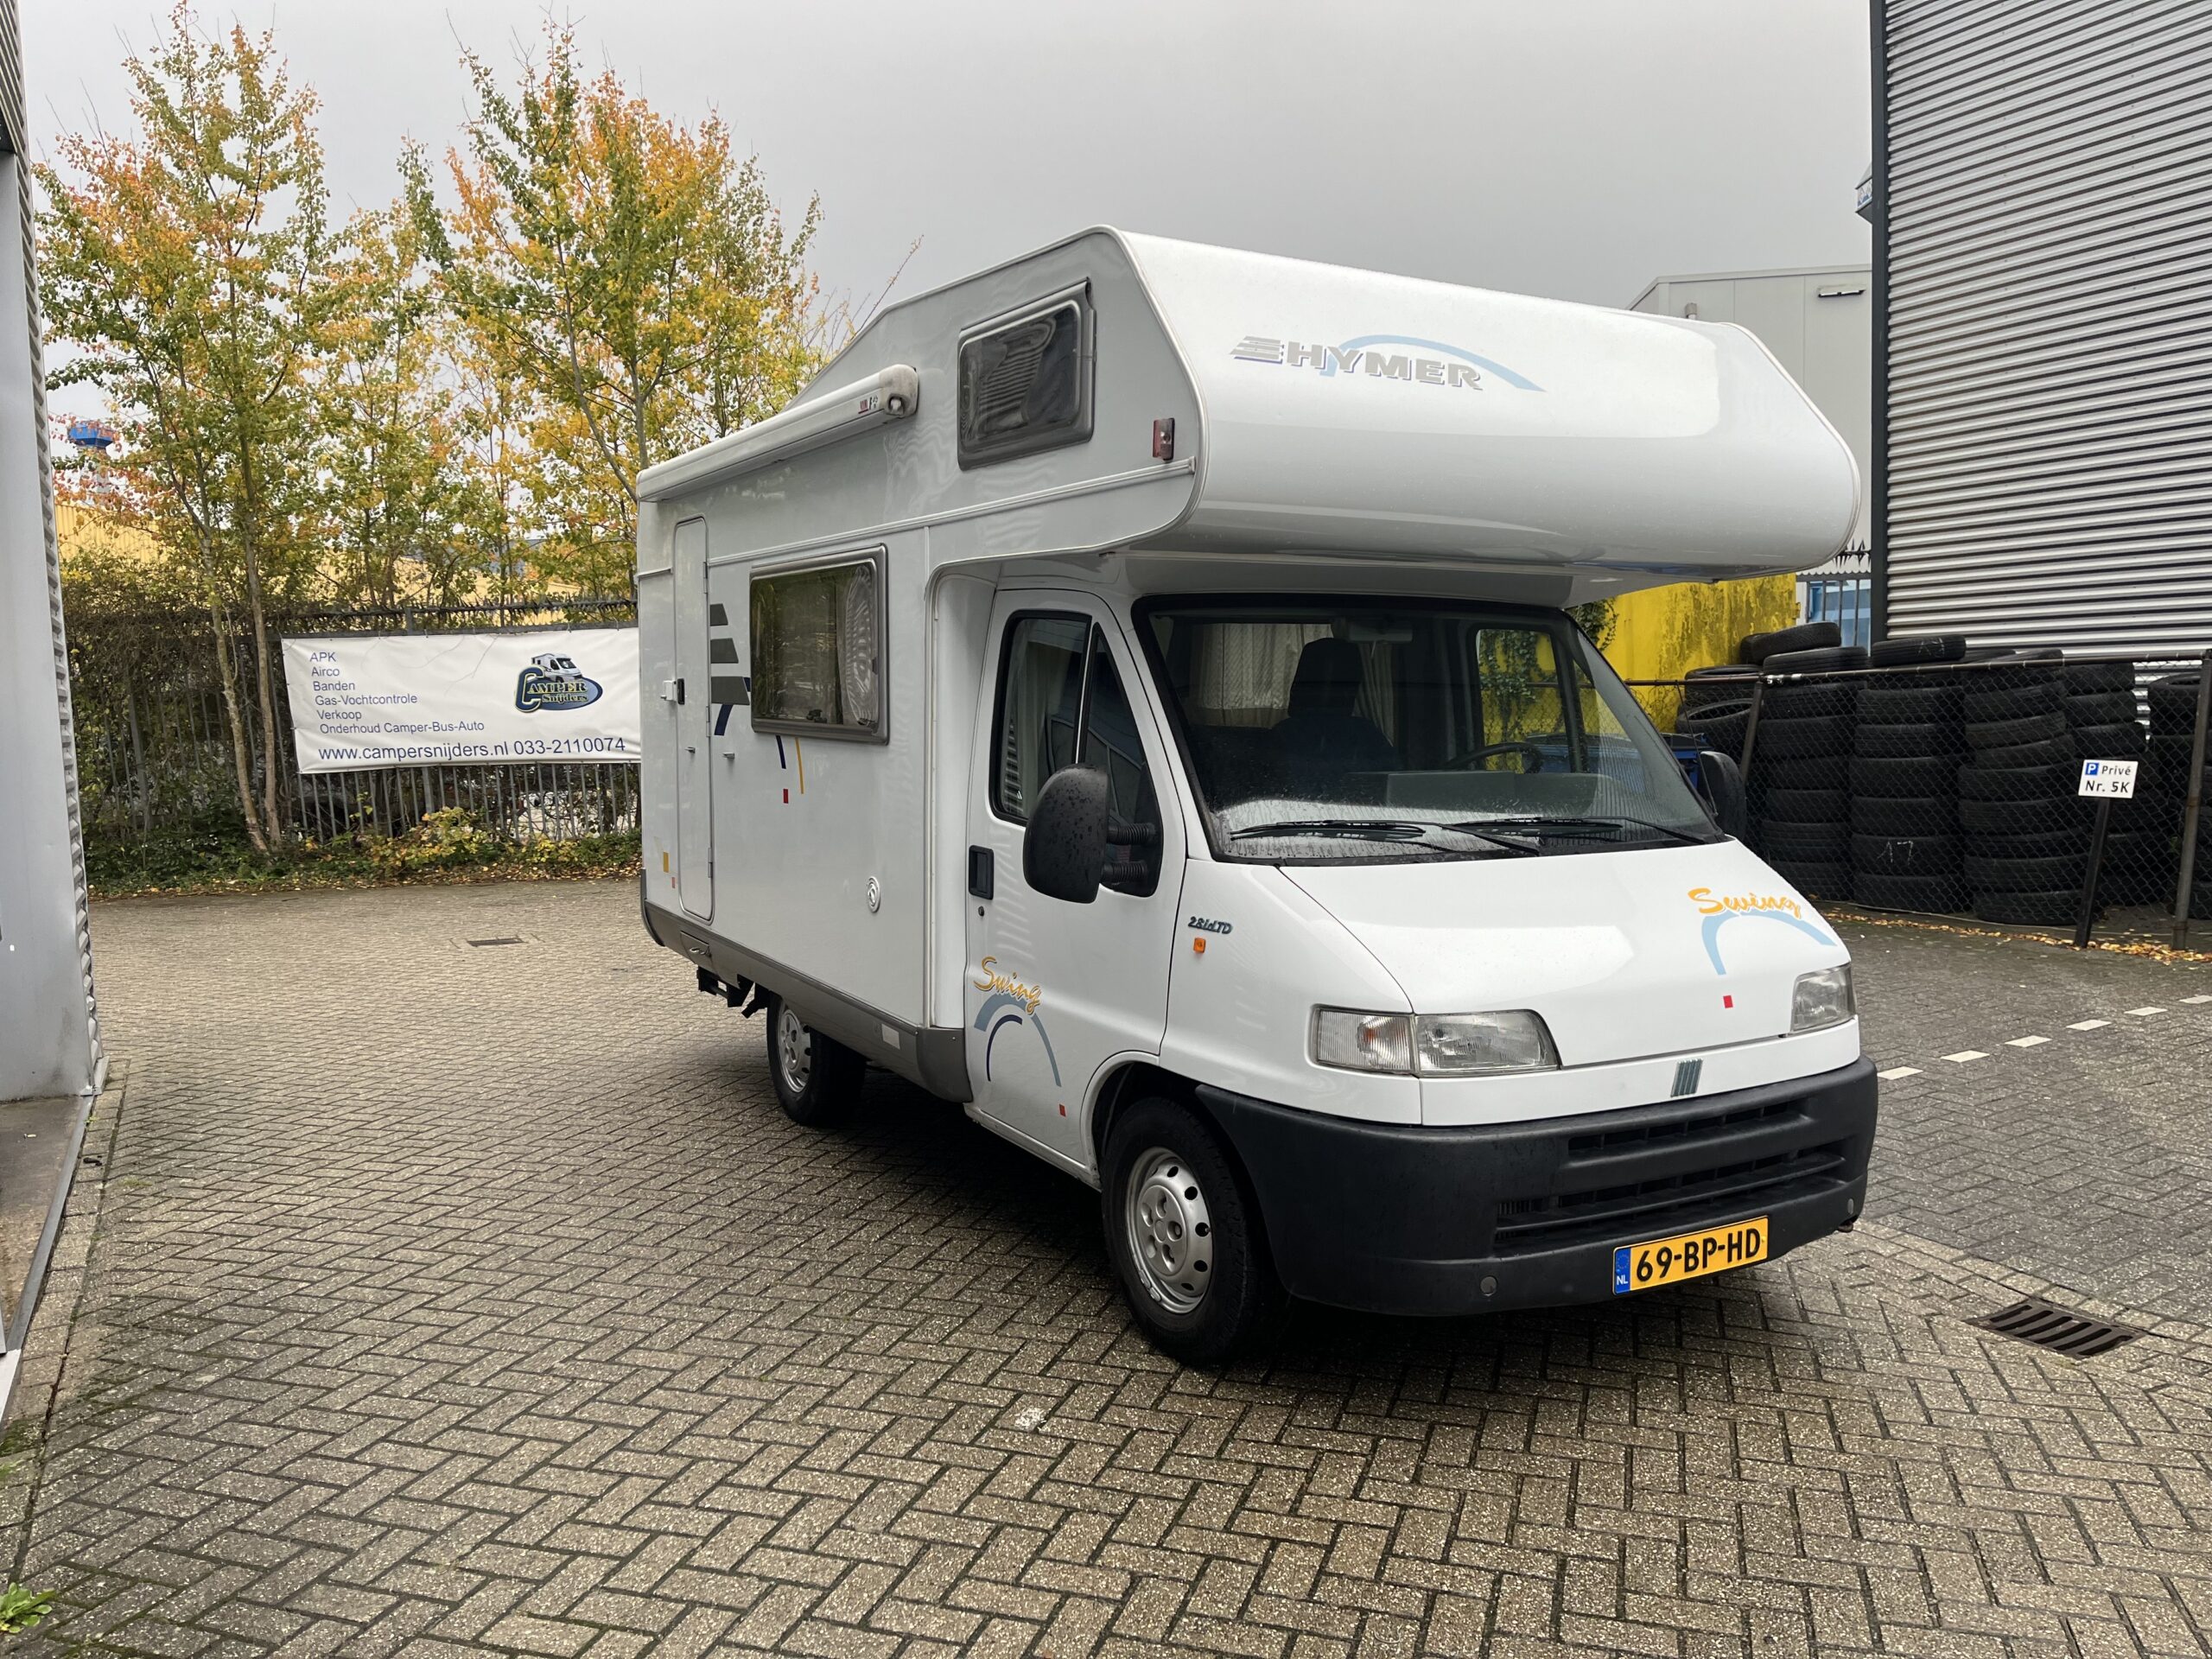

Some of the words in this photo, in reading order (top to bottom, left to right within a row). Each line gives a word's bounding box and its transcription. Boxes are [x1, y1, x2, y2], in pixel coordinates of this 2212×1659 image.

[1287, 340, 1483, 391] HYMER
[309, 652, 337, 663] APK
[311, 666, 340, 677] Airco
[313, 681, 356, 691] Banden
[315, 694, 418, 706] Gas-Vochtcontrole
[541, 694, 589, 704] Snijders
[316, 709, 362, 721] Verkoop
[320, 723, 381, 734] Onderhoud
[383, 721, 485, 734] Camper-Bus-Auto
[318, 741, 508, 762] www.campersnijders.nl
[513, 737, 626, 755] 033-2110074
[2101, 765, 2131, 775] Privé
[2085, 780, 2106, 792] Nr.
[2111, 781, 2130, 793] 5K
[1688, 887, 1802, 919] Swing
[974, 956, 1041, 1015] Swing
[1636, 1228, 1761, 1282] 69-BP-HD
[1616, 1274, 1629, 1286] NL
